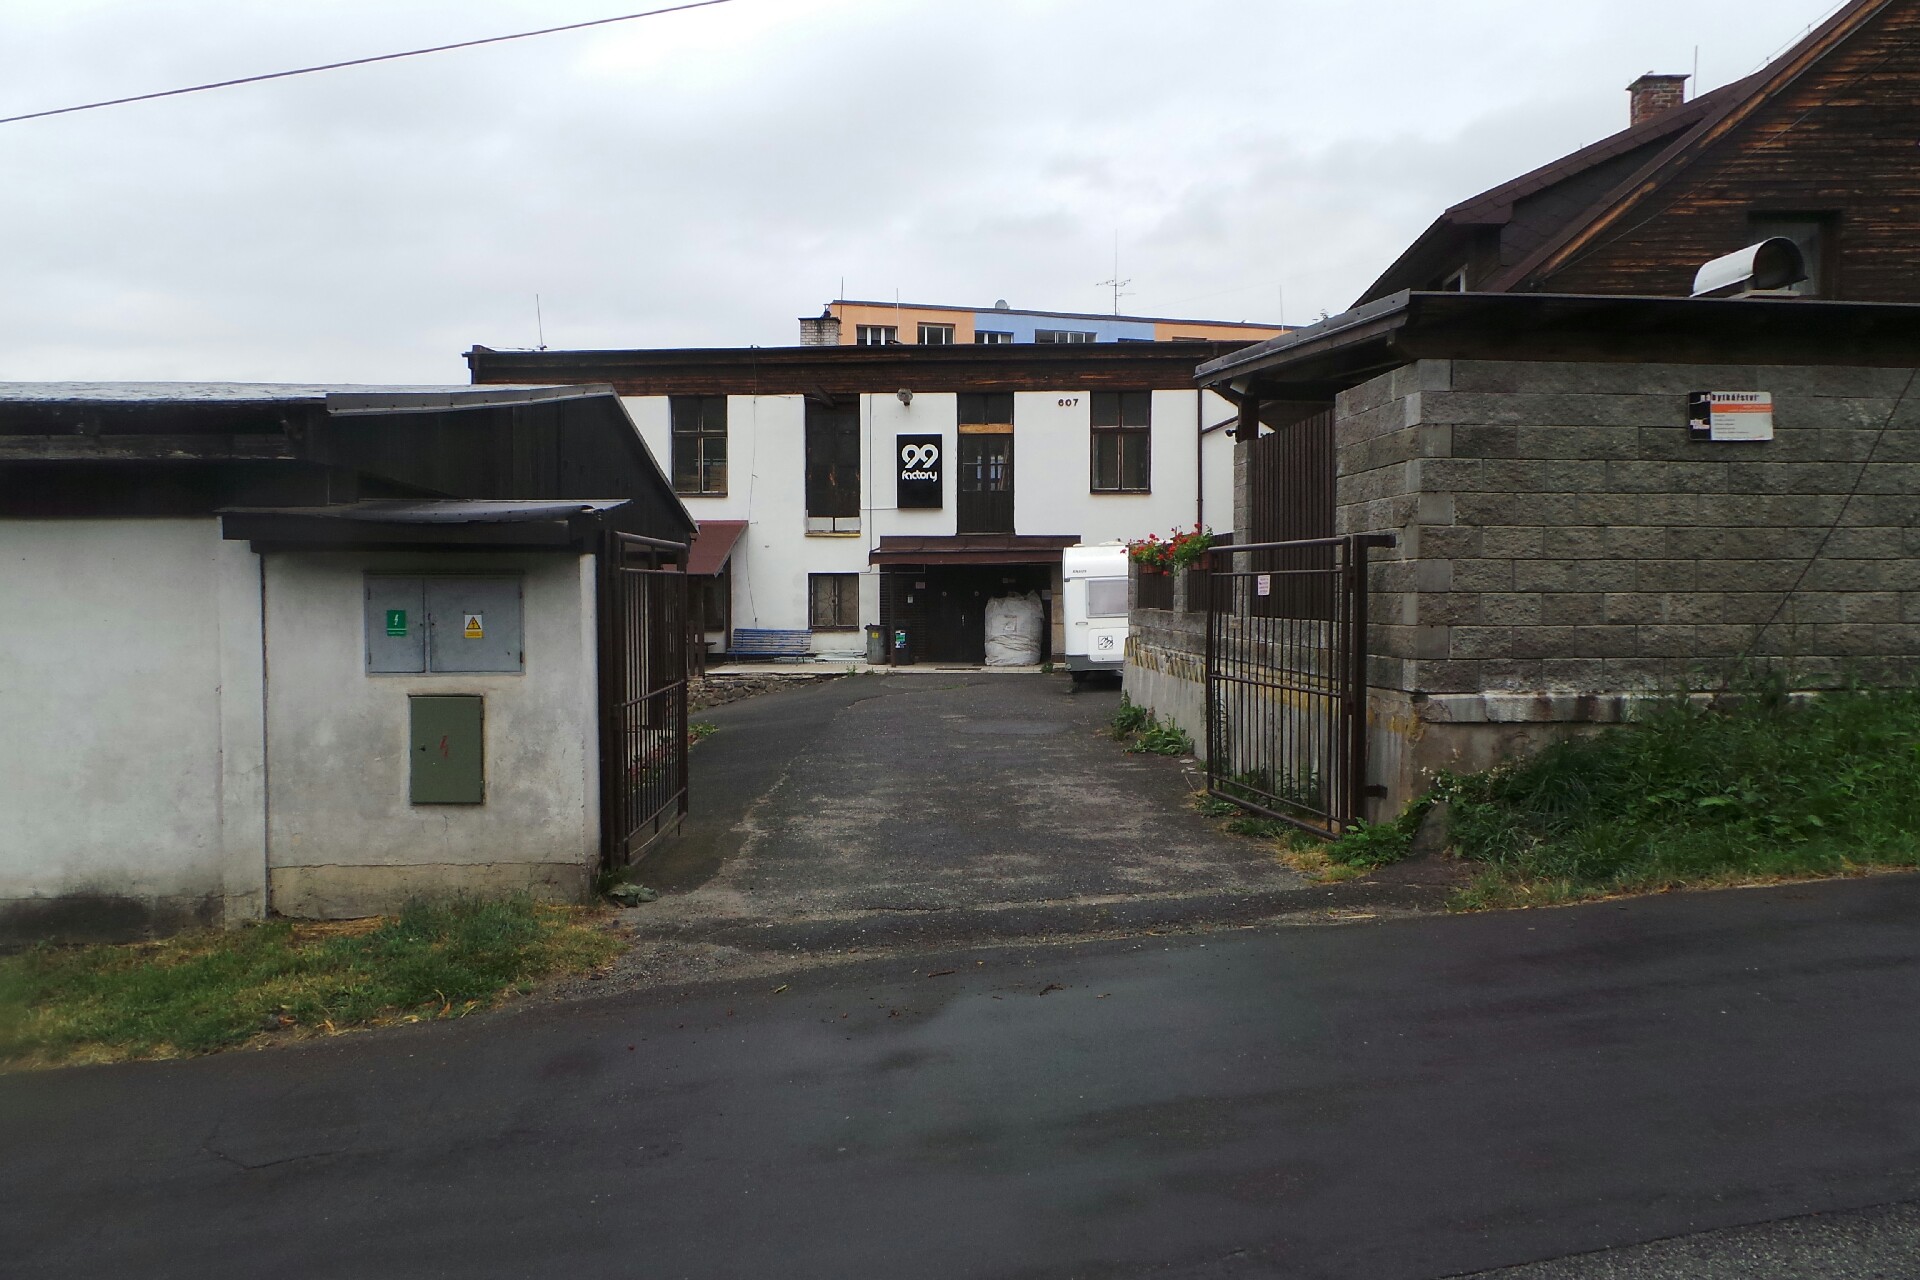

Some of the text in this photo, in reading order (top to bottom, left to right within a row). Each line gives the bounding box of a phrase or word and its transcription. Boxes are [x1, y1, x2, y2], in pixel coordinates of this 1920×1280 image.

[1058, 398, 1079, 407] 607
[901, 443, 939, 468] 99
[902, 470, 938, 482] factory
